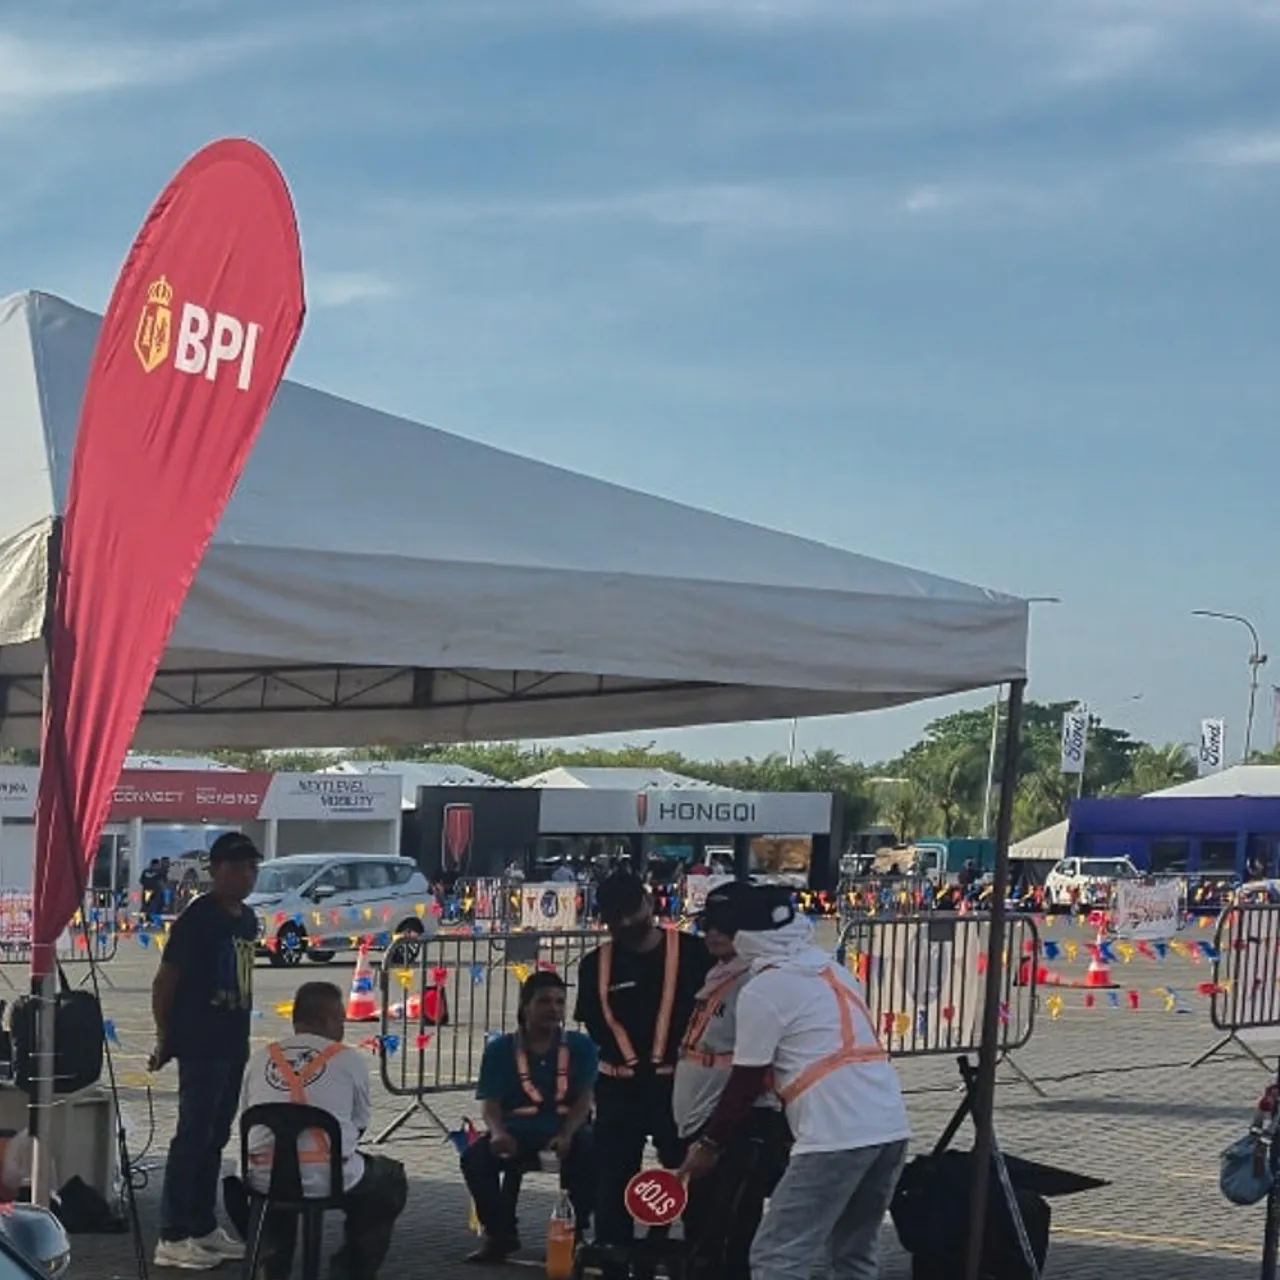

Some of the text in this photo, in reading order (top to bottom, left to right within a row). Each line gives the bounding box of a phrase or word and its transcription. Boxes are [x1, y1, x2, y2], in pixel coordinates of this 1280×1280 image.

[174, 302, 262, 391] BPI
[659, 803, 755, 822] HONGQI
[633, 1179, 676, 1215] STOP
